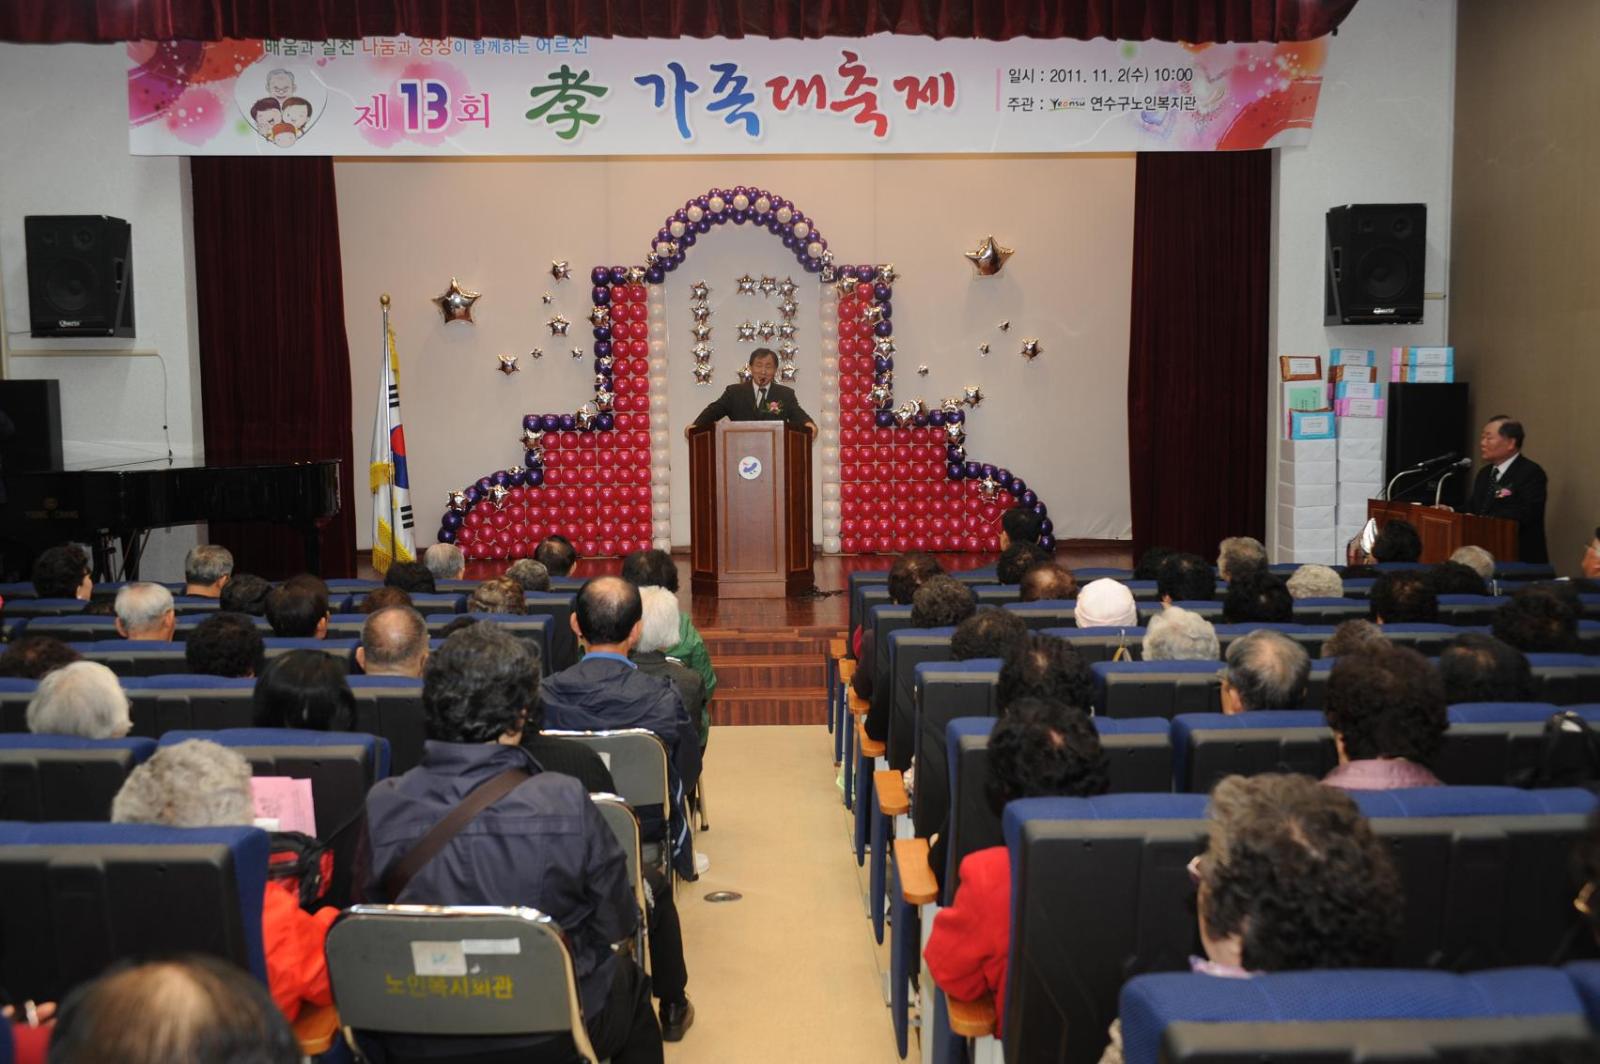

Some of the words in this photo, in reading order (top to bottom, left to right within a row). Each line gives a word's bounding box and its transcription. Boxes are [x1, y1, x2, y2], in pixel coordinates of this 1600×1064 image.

[362, 37, 412, 56] 나눔과
[473, 38, 530, 55] 함께하는
[1117, 66, 1149, 83] 2(수)
[1154, 67, 1194, 82] 10:00
[525, 63, 609, 140] 孝
[1090, 95, 1197, 112] 연수구노인복지관
